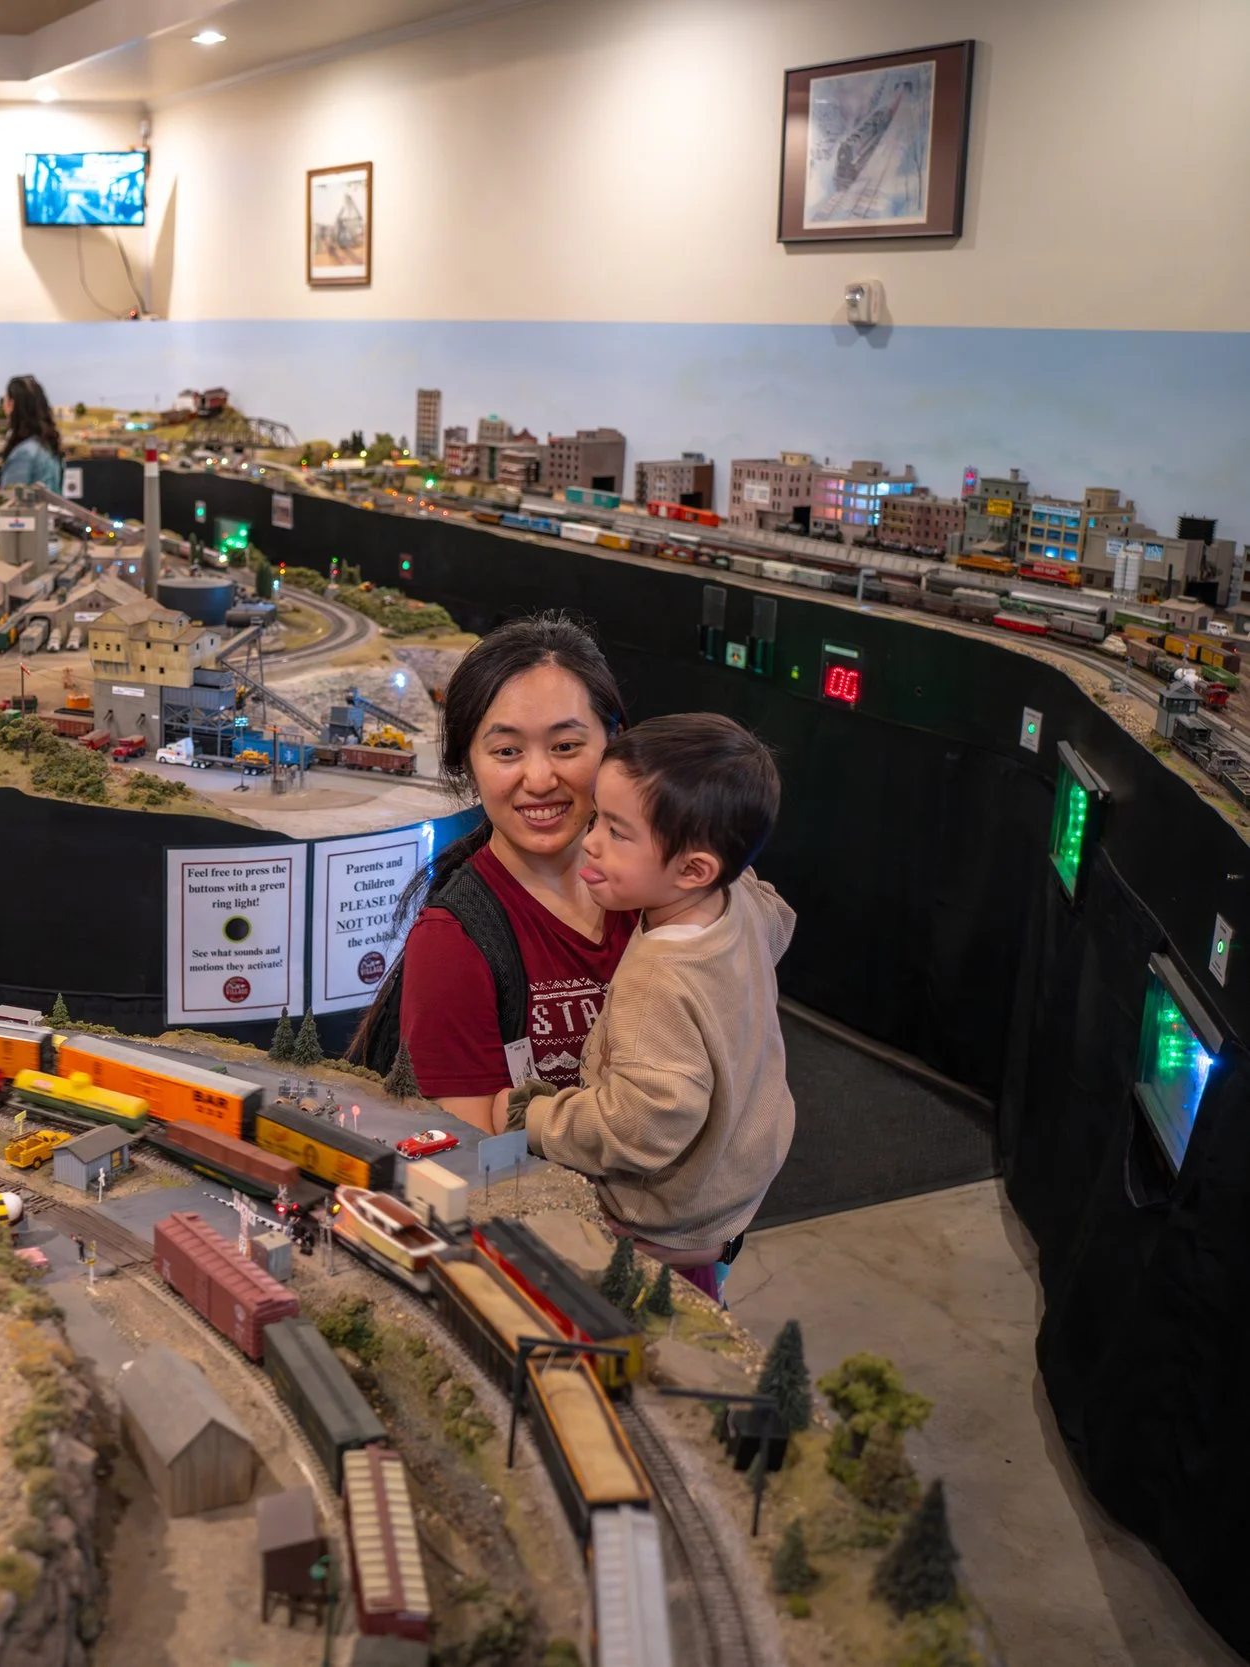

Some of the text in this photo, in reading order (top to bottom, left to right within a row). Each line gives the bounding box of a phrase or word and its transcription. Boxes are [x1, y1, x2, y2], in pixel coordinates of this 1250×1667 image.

[187, 864, 287, 878] Feel free to press the
[346, 856, 403, 875] Parents and
[188, 883, 225, 894] buttons
[227, 882, 249, 892] with
[259, 881, 285, 893] green
[354, 878, 395, 892] Children
[212, 897, 260, 909] ring light!
[339, 895, 387, 913] PLEASE
[336, 918, 363, 932] NOT
[347, 937, 363, 948] the
[192, 945, 281, 958] See what sounds and
[189, 959, 283, 972] motions they activate!
[193, 1090, 229, 1109] BAR
